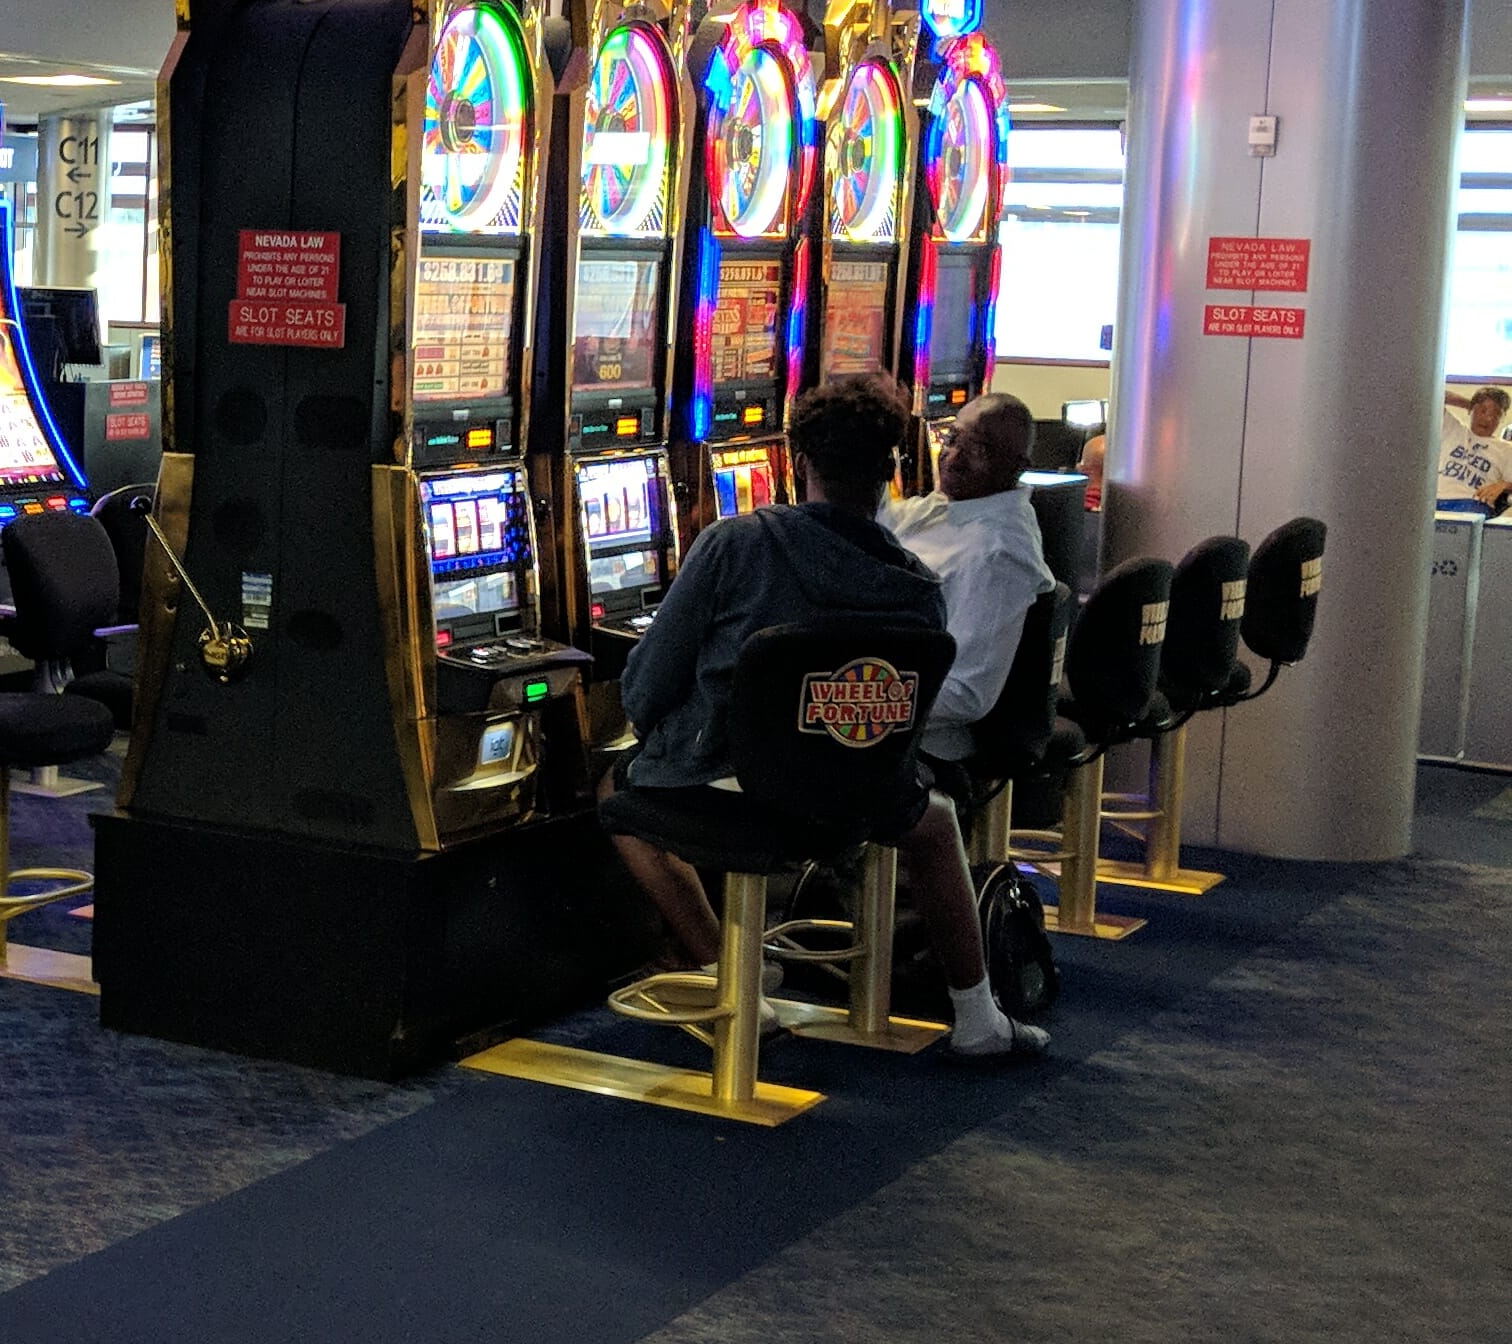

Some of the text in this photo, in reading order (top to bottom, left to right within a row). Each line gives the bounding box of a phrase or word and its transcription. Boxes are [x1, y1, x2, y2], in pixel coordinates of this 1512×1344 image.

[59, 136, 99, 166] C11
[55, 191, 98, 220] C12
[255, 235, 325, 248] NEVADA LAW
[1222, 242, 1295, 252] NEVADA LAW
[243, 251, 335, 263] PROHIBITS ANY PERSONS
[248, 264, 273, 273] UNDER
[275, 264, 289, 273] THE
[291, 265, 306, 274] AGE
[321, 266, 329, 274] 21
[253, 275, 324, 286] TO PLAY OR LOITER
[246, 288, 327, 298] NEAR SLOT MACHINES
[240, 306, 335, 327] SLOT SEATS
[1212, 308, 1296, 323] SLOT SEATS
[235, 325, 339, 341] ARE FOR SLOT PLAYERS ONLY
[1209, 323, 1220, 332] ARE
[1222, 323, 1235, 331] FOR
[1236, 324, 1252, 332] SLOT
[599, 364, 622, 380] 600
[810, 679, 915, 702] WHEEL OF
[806, 701, 912, 723] FORTUNE
